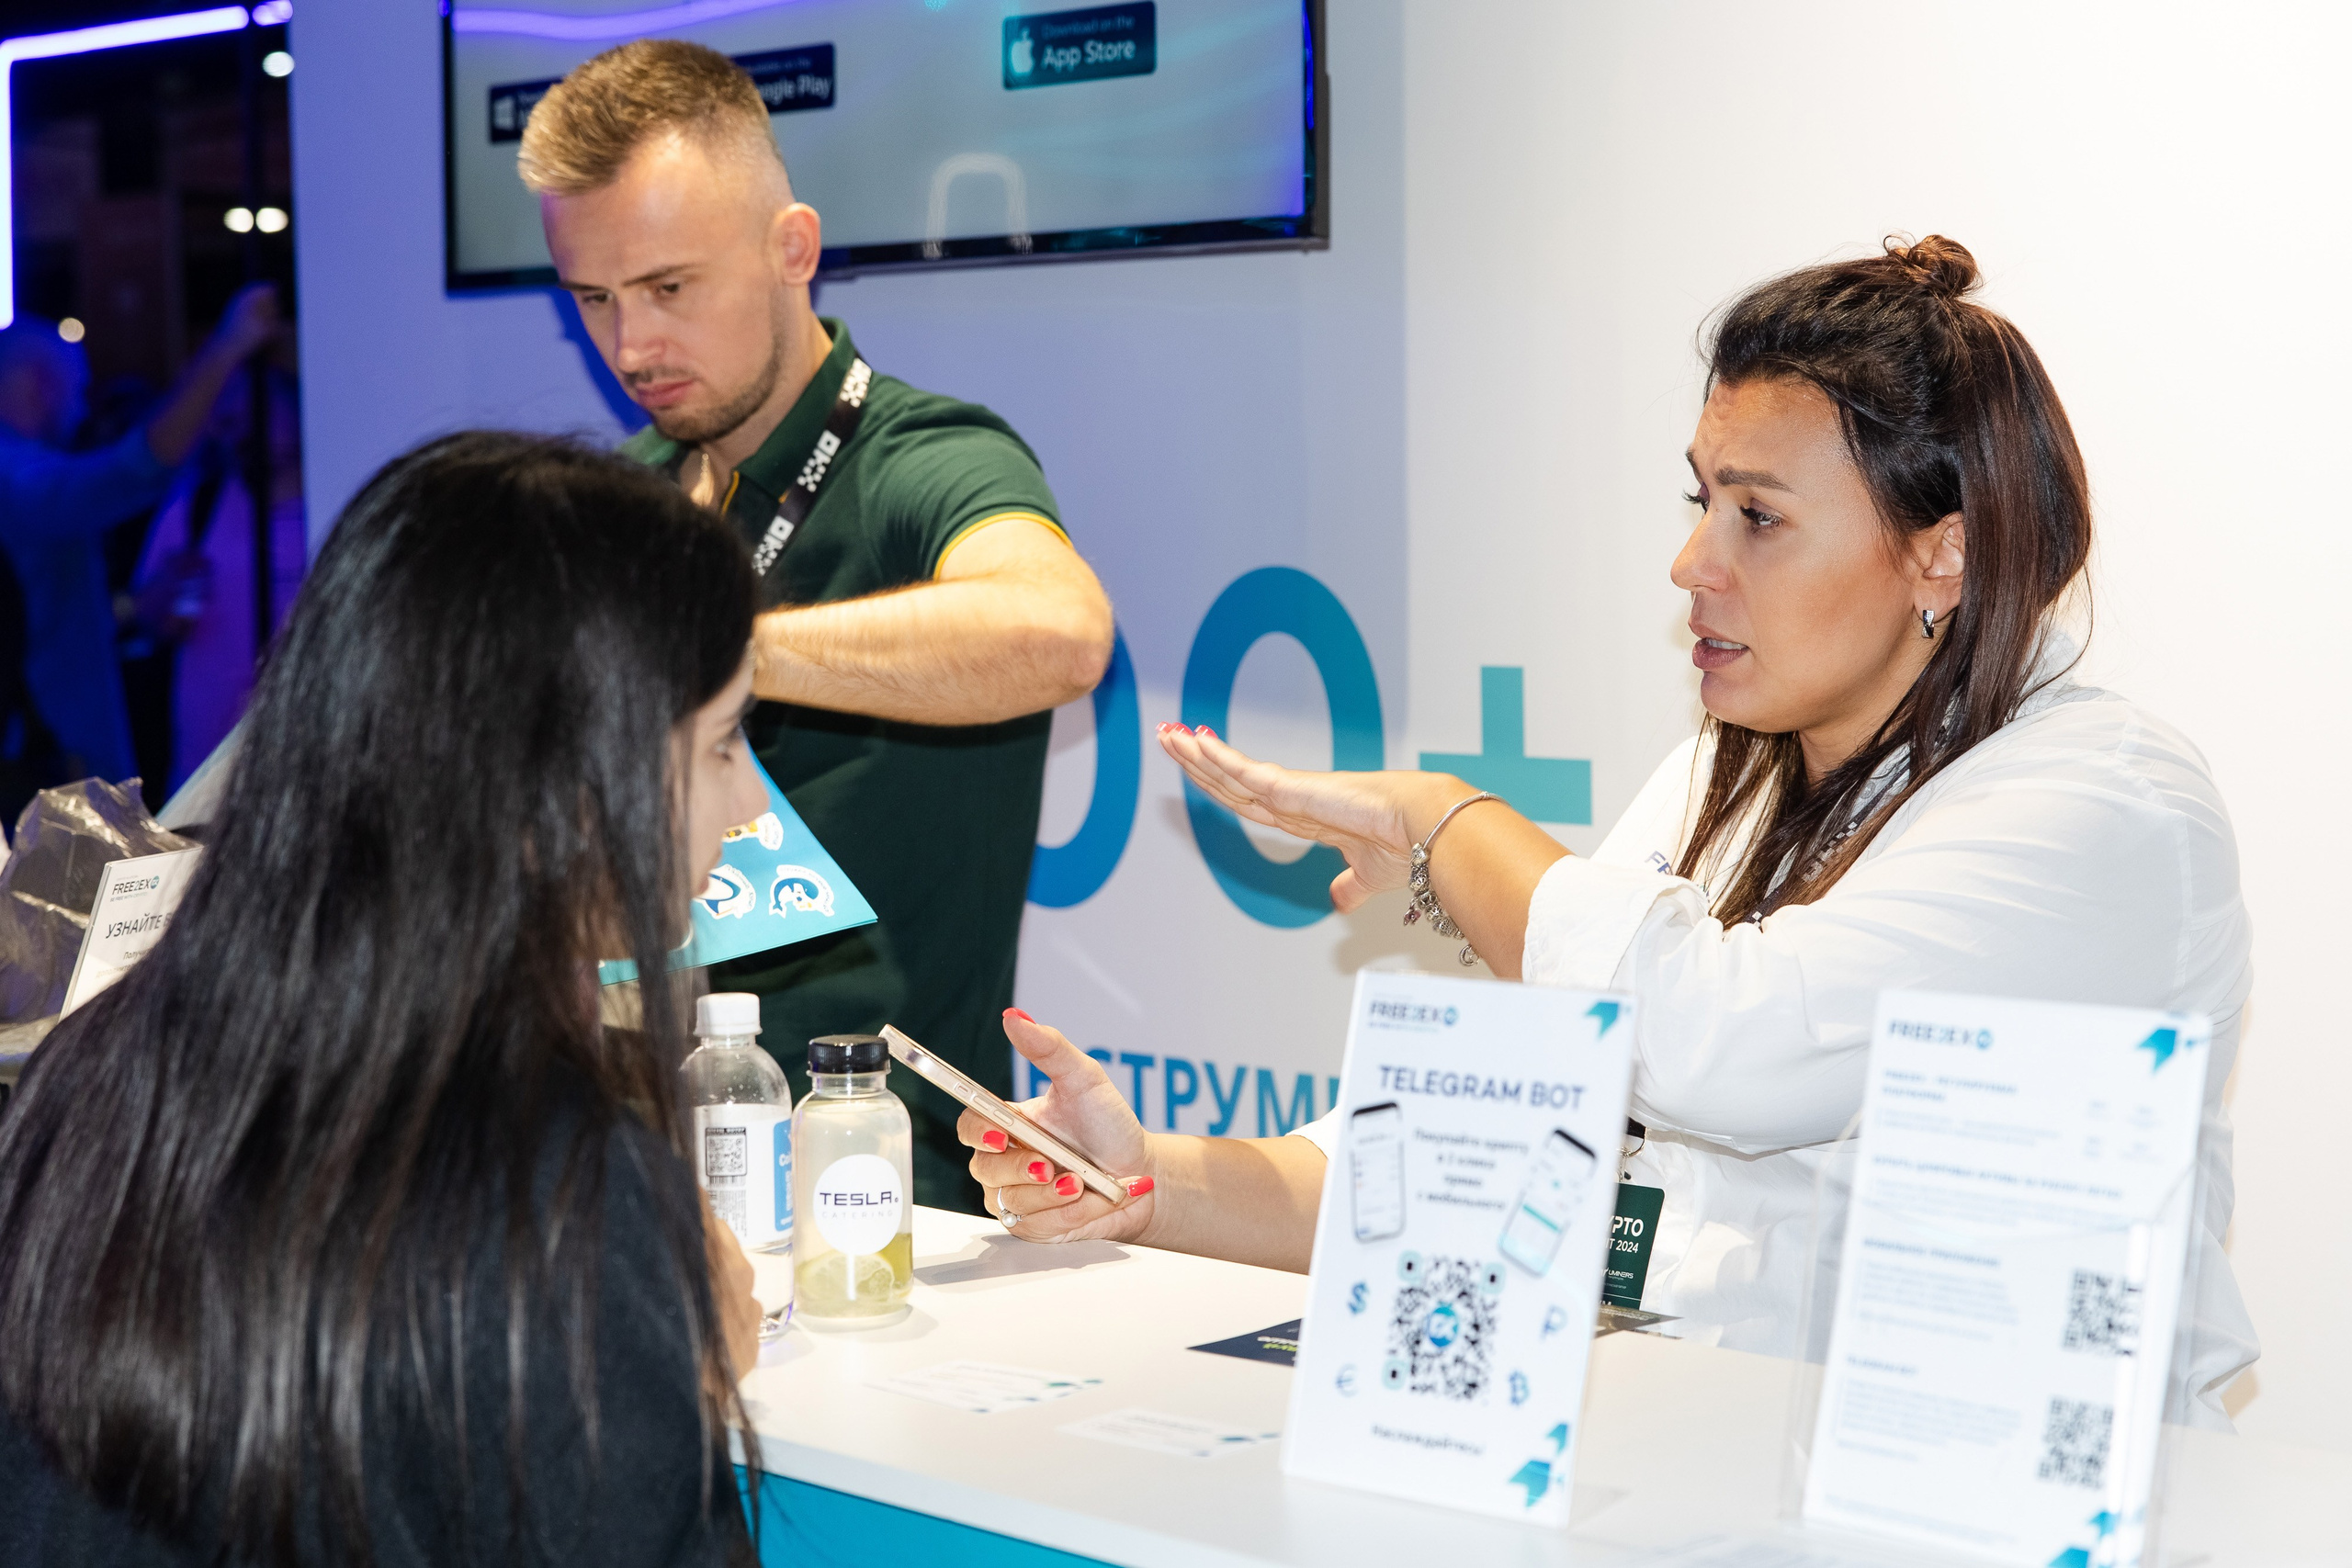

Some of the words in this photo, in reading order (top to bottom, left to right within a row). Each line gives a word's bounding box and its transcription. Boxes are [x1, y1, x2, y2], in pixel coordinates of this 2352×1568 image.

[1041, 46, 1081, 73] App
[1084, 39, 1136, 63] Store
[112, 879, 152, 896] FREE2EX
[106, 912, 164, 939] УЗНАЙТЕ
[1378, 1064, 1523, 1102] TELEGRAM
[1530, 1081, 1587, 1111] BOT
[820, 1191, 892, 1205] TESLA
[1615, 1239, 1639, 1254] 2024
